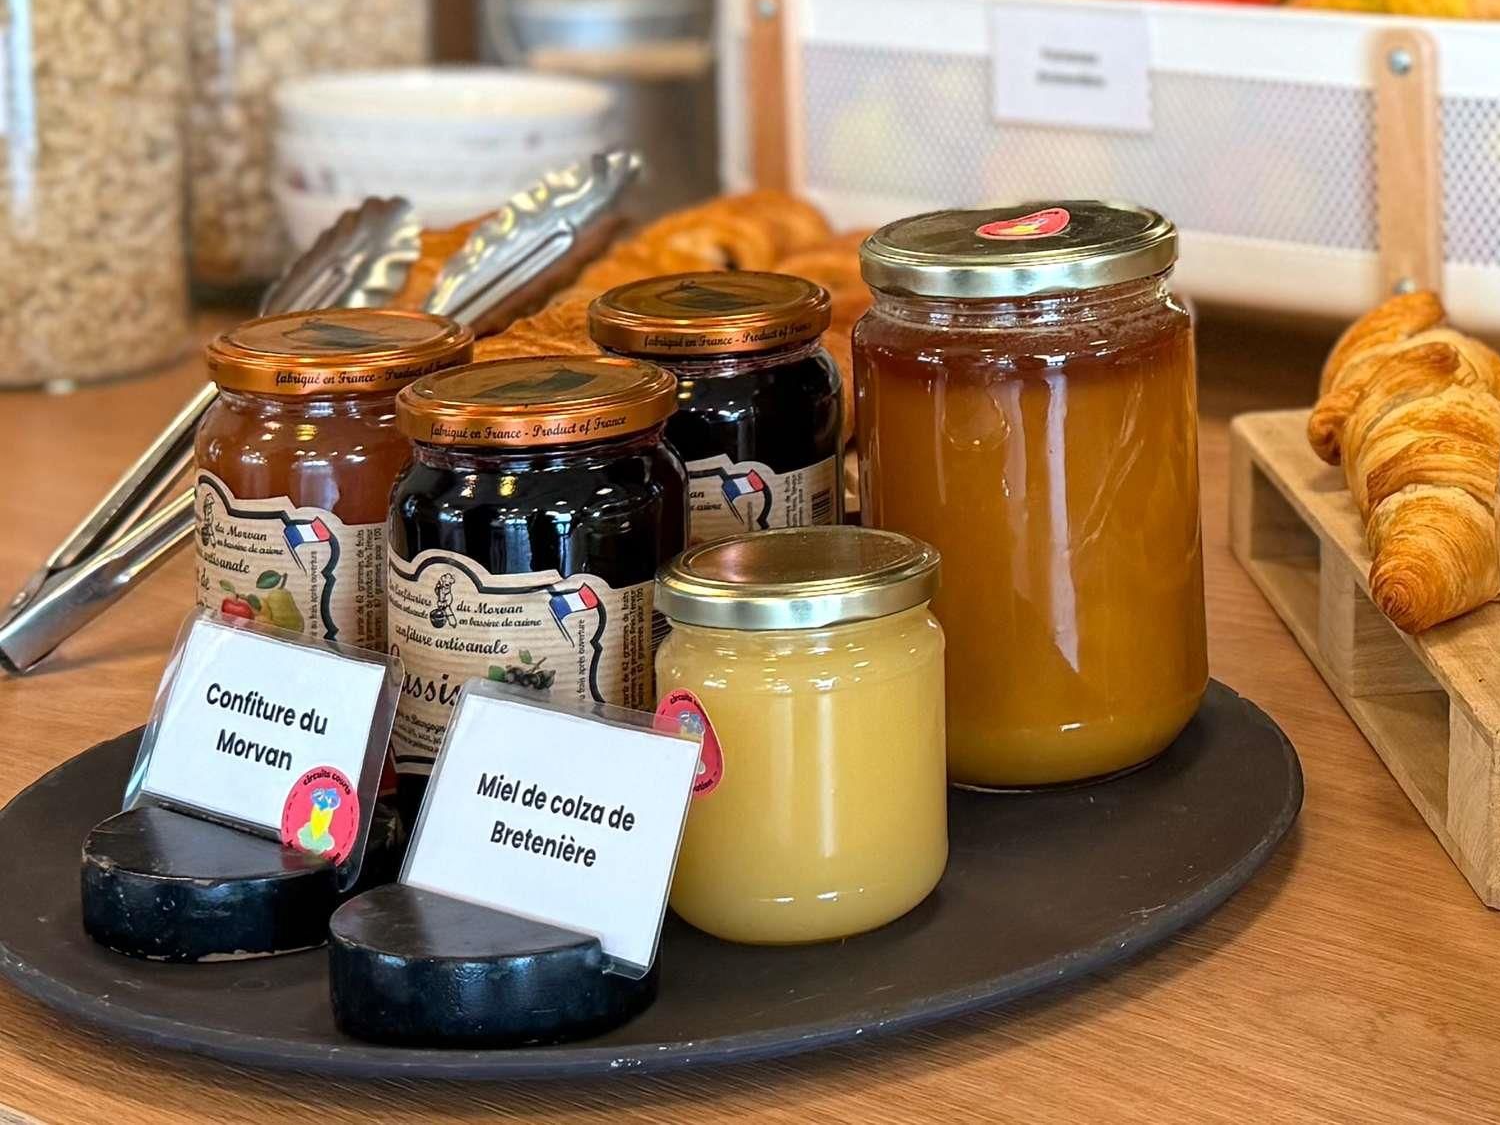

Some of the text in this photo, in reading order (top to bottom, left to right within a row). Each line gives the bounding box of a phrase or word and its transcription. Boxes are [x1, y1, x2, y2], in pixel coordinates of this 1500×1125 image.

[275, 371, 321, 388] fabriqué
[322, 374, 336, 385] en
[337, 370, 376, 384] France
[430, 423, 470, 439] fabriqué
[470, 431, 481, 439] en
[484, 426, 522, 439] France
[532, 423, 577, 438] Product
[579, 420, 592, 435] of
[593, 416, 627, 431] France
[227, 525, 267, 541] Morvan
[456, 600, 471, 613] du
[474, 602, 523, 615] Morvan
[469, 616, 500, 628] bassine
[502, 616, 513, 627] de
[435, 636, 510, 655] artisanale
[577, 618, 586, 655] ouverture
[576, 656, 587, 675] après
[206, 681, 329, 736] Confiture du
[216, 728, 294, 772] Morvan
[302, 768, 331, 786] circuits
[476, 772, 636, 833] Miel de colza de
[490, 819, 598, 868] Bretenière
